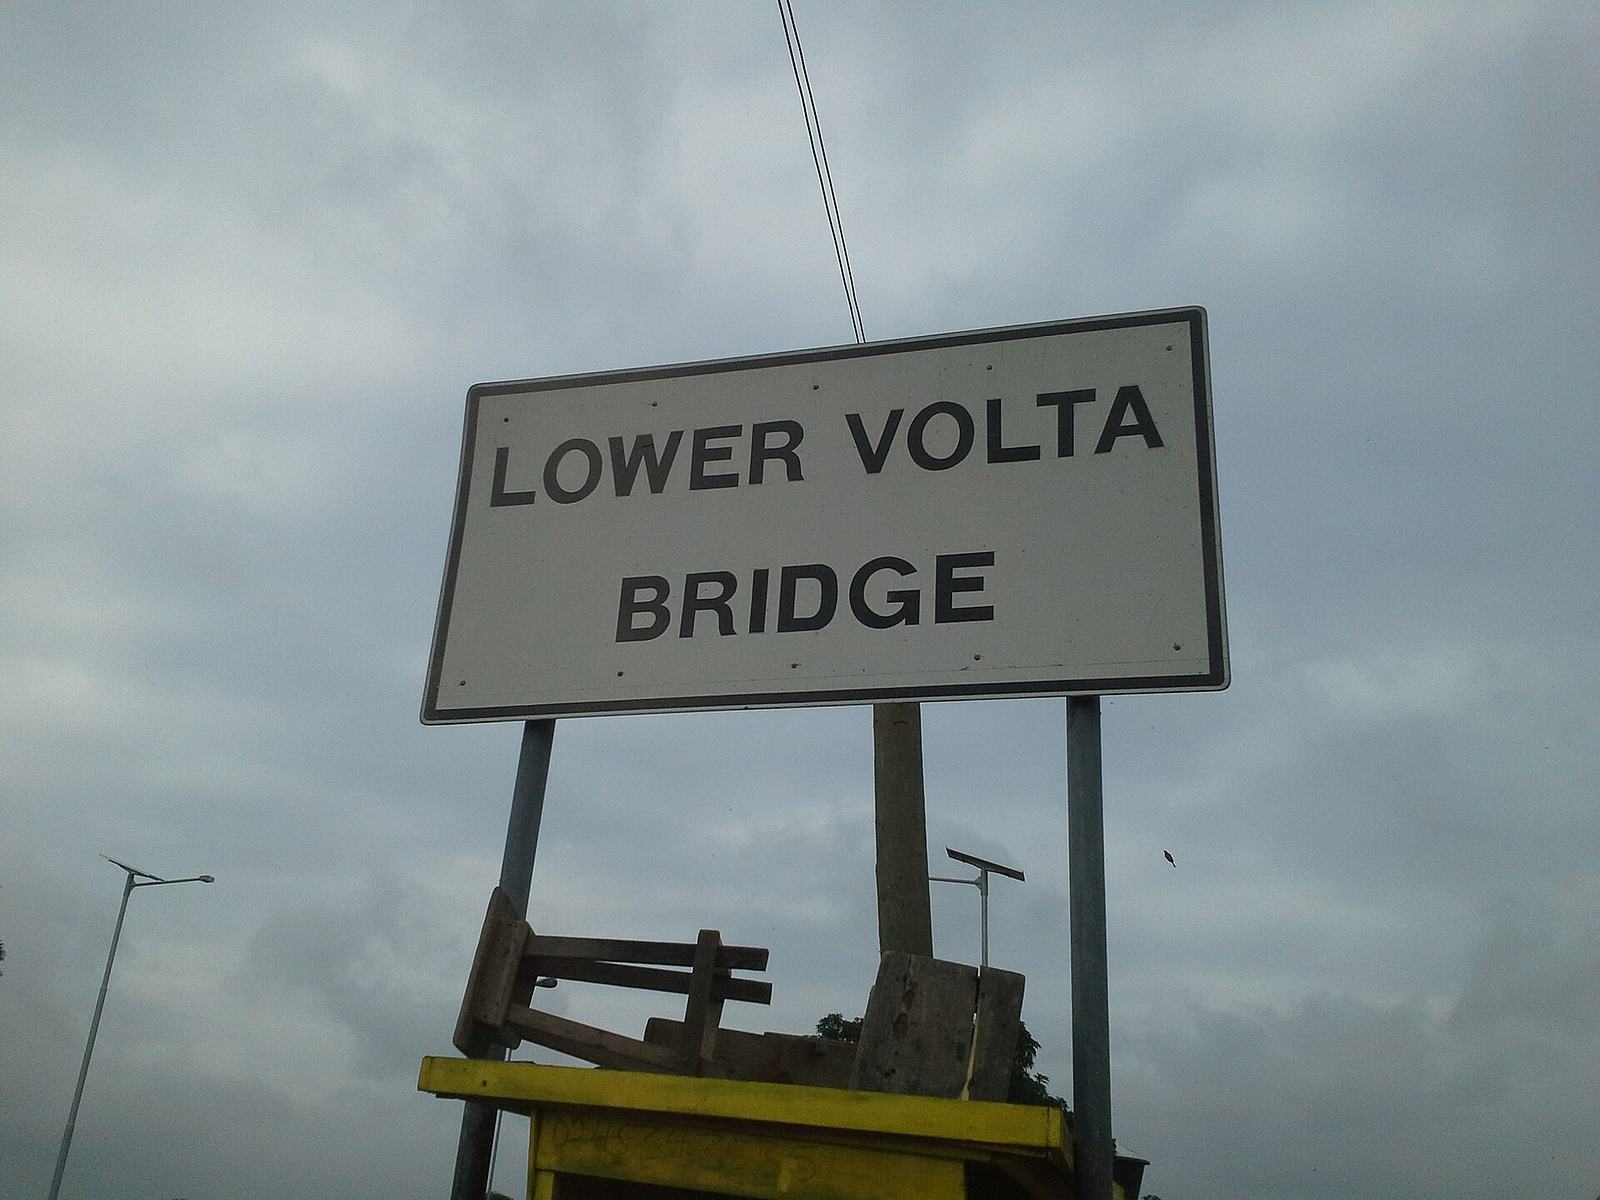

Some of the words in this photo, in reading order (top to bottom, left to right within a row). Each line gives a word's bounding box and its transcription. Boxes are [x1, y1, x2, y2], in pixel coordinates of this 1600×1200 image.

[489, 419, 805, 508] LOWER
[844, 384, 1165, 475] VOLTA
[614, 550, 997, 643] BRIDGE
